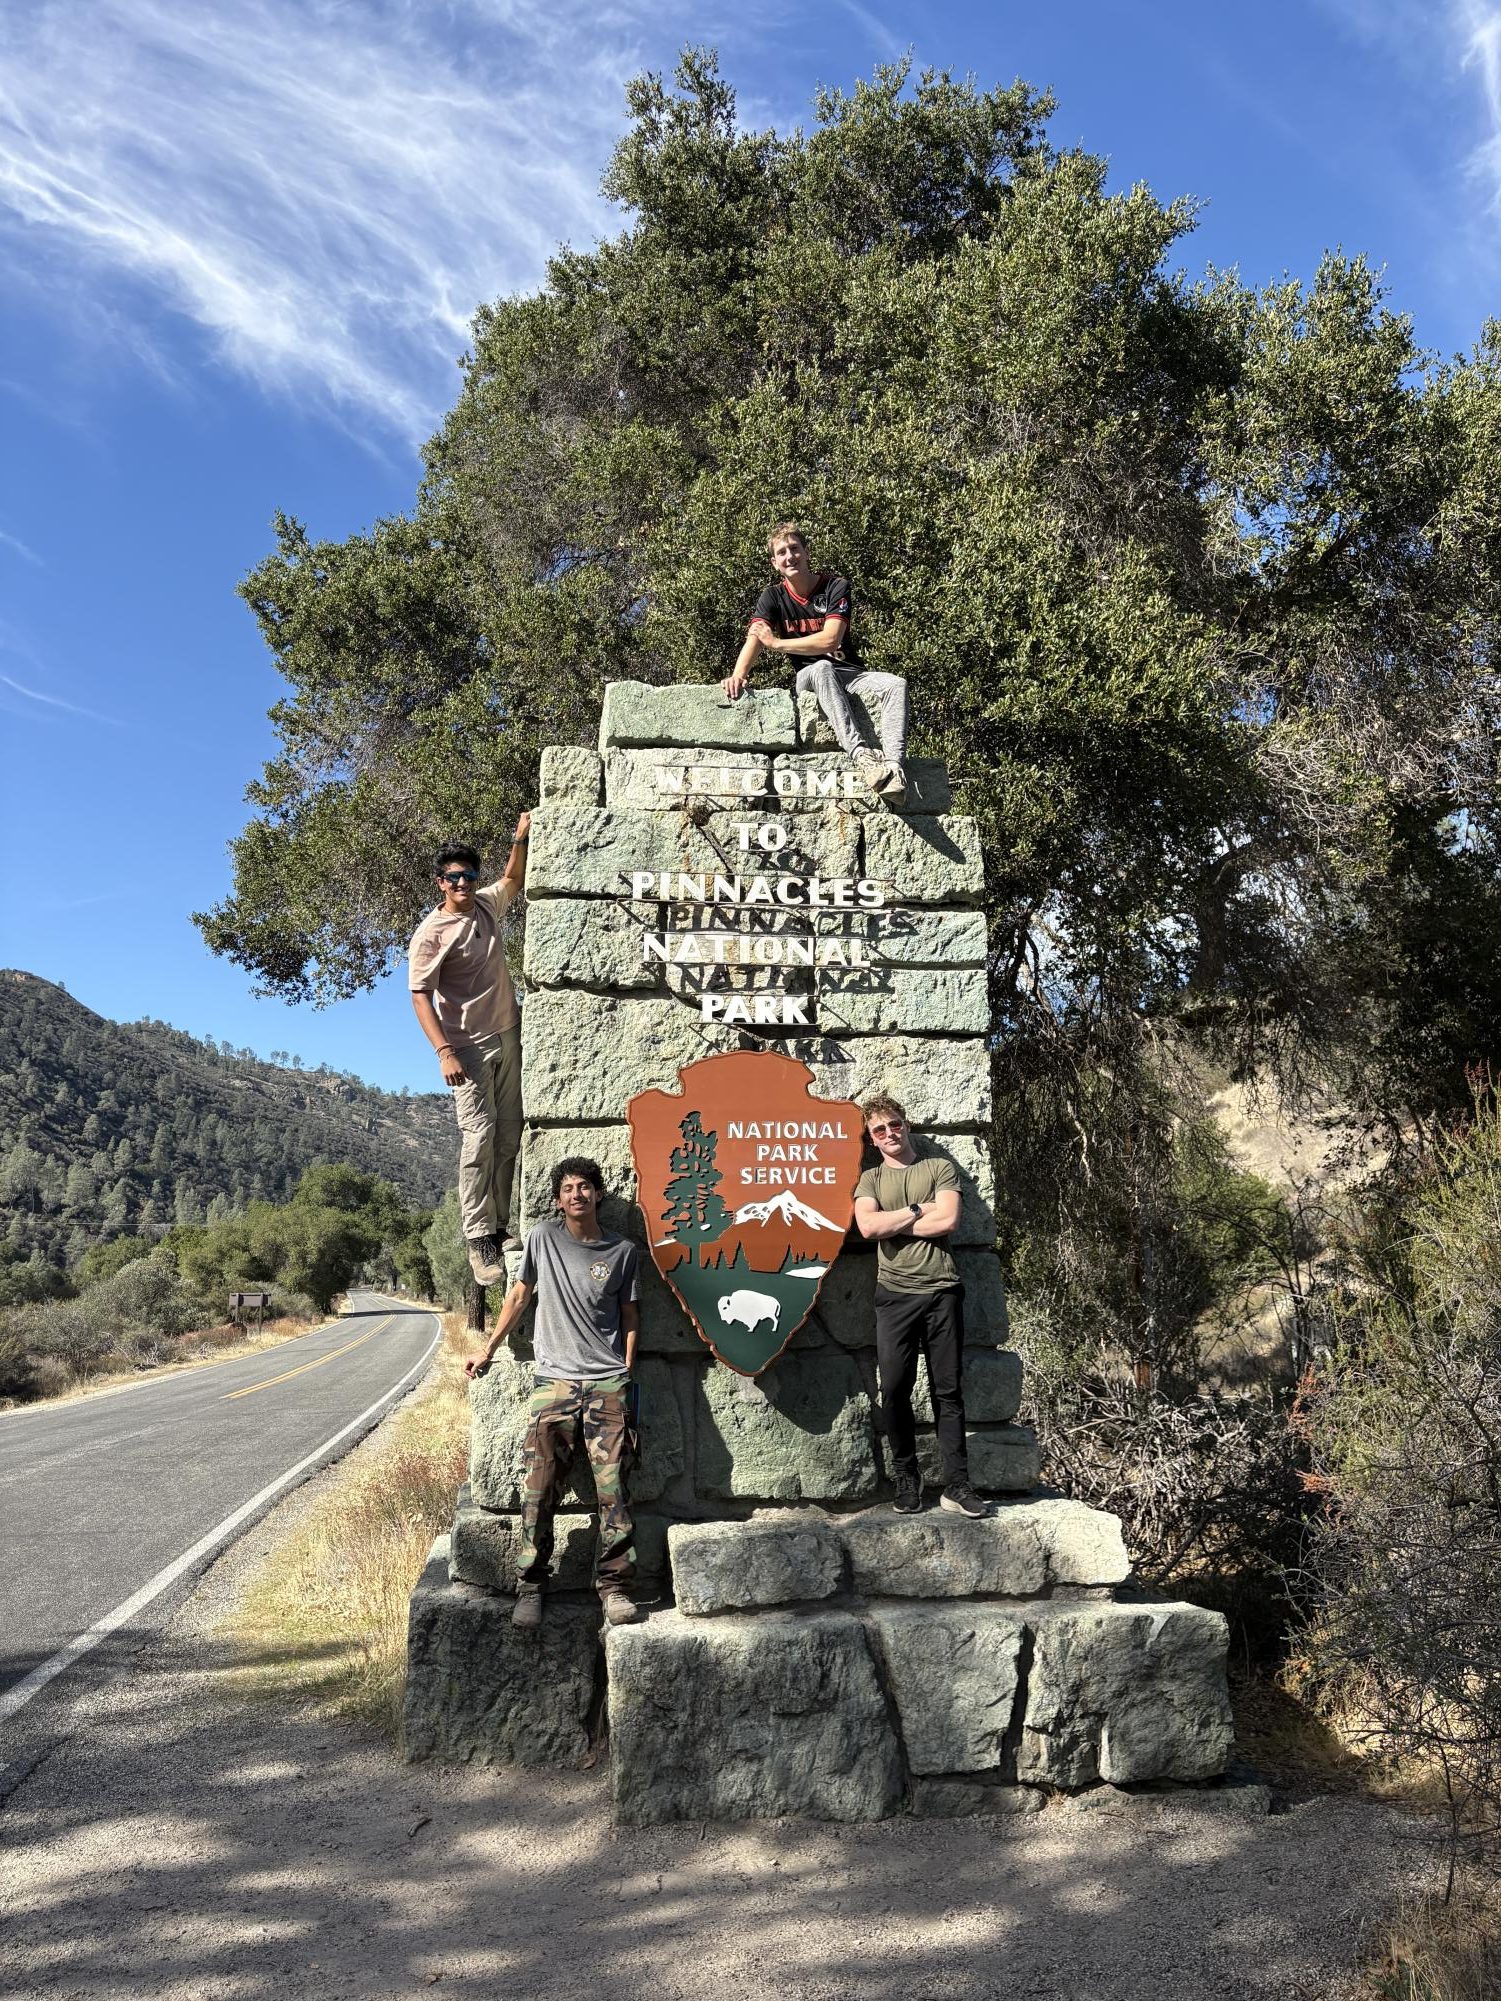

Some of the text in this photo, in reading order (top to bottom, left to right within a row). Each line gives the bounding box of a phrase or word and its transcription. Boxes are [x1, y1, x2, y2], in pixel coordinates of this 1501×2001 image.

[654, 768, 865, 799] WELCOME
[732, 822, 787, 852] TO
[632, 871, 886, 908] PINNACLES
[643, 933, 872, 968] NATIONAL
[701, 993, 810, 1024] PARK
[727, 1121, 847, 1139] NATIONAL
[757, 1144, 819, 1161] PARK
[740, 1167, 836, 1184] SERVICE
